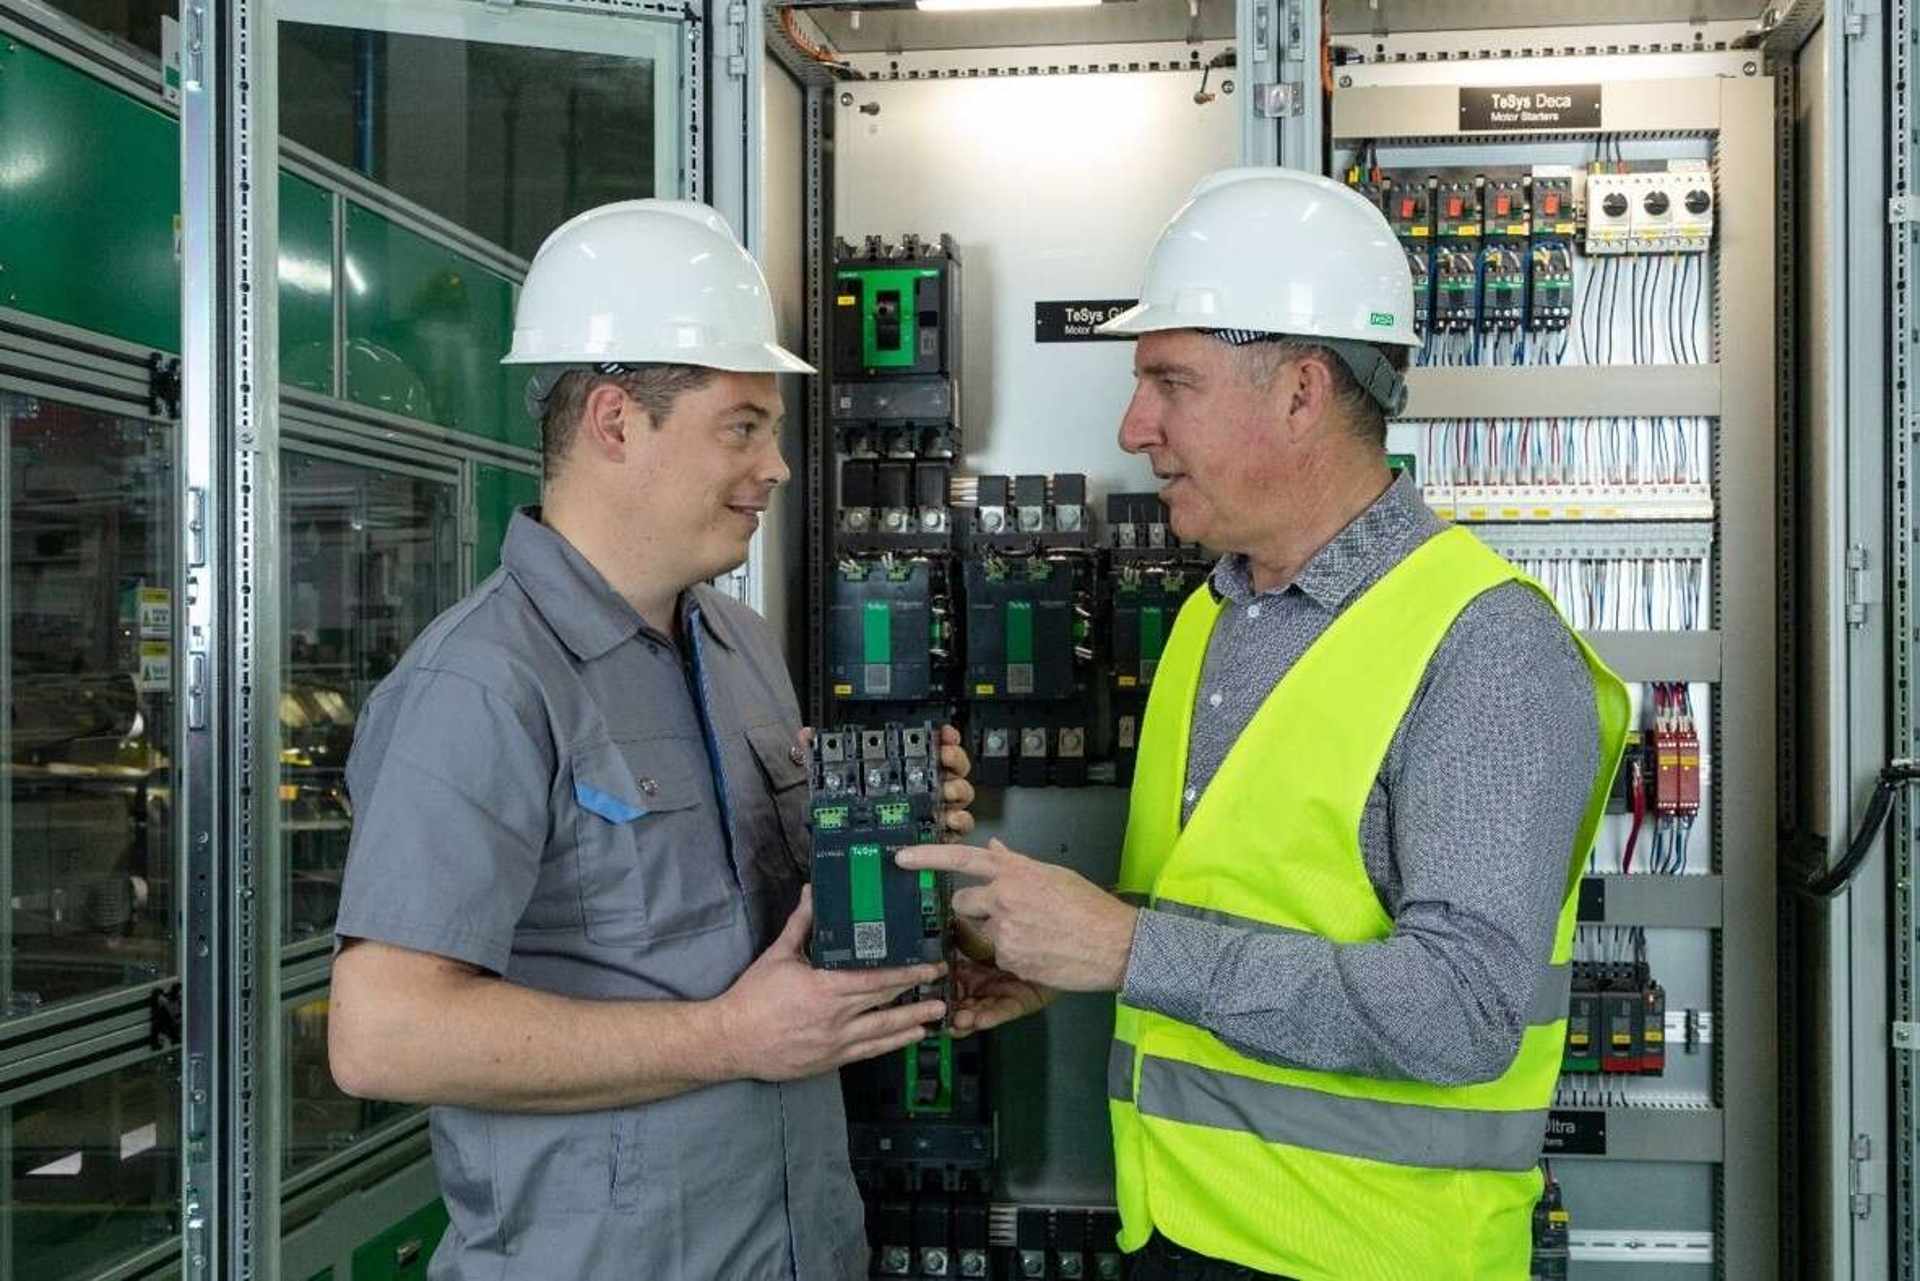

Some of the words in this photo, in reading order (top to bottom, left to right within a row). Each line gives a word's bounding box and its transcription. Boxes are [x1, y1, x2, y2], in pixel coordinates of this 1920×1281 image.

[1491, 94, 1531, 111] TeSys
[1535, 93, 1572, 108] Deca
[1064, 307, 1104, 325] TeSys
[1064, 326, 1091, 335] Motor
